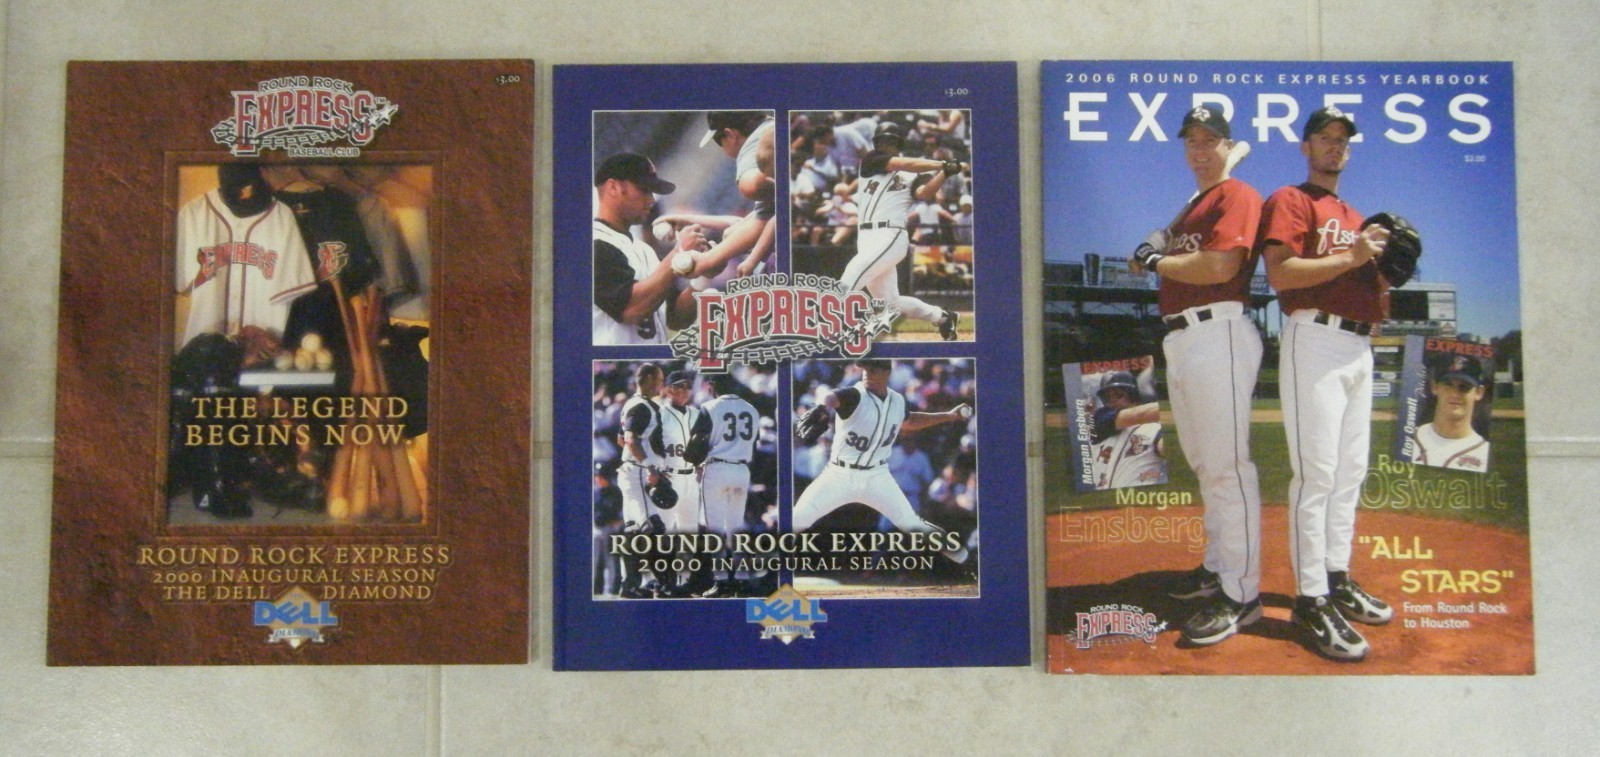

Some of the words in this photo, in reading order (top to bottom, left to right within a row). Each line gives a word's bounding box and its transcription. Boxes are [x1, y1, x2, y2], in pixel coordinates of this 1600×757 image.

[259, 76, 309, 93] ROUND
[313, 77, 353, 93] ROCK
[1066, 73, 1116, 84] 2006
[1130, 73, 1199, 84] ROUND
[1213, 73, 1265, 84] ROCK
[1278, 74, 1367, 85] EXPRESS
[1380, 74, 1490, 85] YEARBOOK
[231, 89, 376, 157] EXPRESS
[288, 147, 334, 157] BASEBALL
[335, 147, 361, 157] CLUB
[727, 273, 789, 294] ROUND
[794, 273, 843, 295] ROCK
[692, 287, 876, 374] EXPRESS
[1426, 338, 1495, 357] EXPRESS
[1082, 357, 1150, 375] EXPRESS
[191, 397, 258, 419] THE
[272, 396, 409, 419] LEGEND
[1403, 397, 1418, 434] Oswalt
[184, 423, 311, 446] BEGINS
[324, 423, 413, 446] NOW.
[722, 411, 753, 442] 33
[664, 443, 684, 458] 46
[845, 430, 869, 452] 30
[1401, 437, 1415, 457] Roy
[1080, 444, 1093, 485] Morgan
[1378, 453, 1416, 479] Roy
[1115, 487, 1192, 510] Morgan
[1360, 467, 1508, 510] Oswalt
[1059, 505, 1210, 553] Ensberg
[609, 532, 723, 556] ROUND
[735, 532, 820, 555] ROCK
[832, 530, 962, 554] EXPRESS
[1358, 535, 1434, 560] "ALL
[138, 546, 240, 566] ROUND
[250, 546, 326, 566] ROCK
[336, 546, 451, 566] EXPRESS
[638, 558, 702, 573] 2000
[711, 556, 842, 572] INAUGURAL
[850, 555, 935, 572] SEASON
[153, 571, 203, 584] 2000
[210, 568, 343, 584] INAUGURAL
[350, 567, 438, 583] SEASON
[1400, 569, 1515, 595] STARS"
[163, 585, 206, 600] THE
[216, 585, 270, 600] DELL
[323, 585, 432, 600] DIAMOND
[254, 600, 338, 626] DELL
[746, 598, 828, 623] DELL
[1090, 603, 1119, 613] ROUND
[1121, 604, 1144, 613] ROCK
[1403, 602, 1433, 614] From
[1437, 602, 1475, 614] Round
[1479, 602, 1508, 614] Rock
[1076, 610, 1158, 650] EXPRESS
[1404, 618, 1417, 629] to
[1421, 617, 1470, 629] Houston
